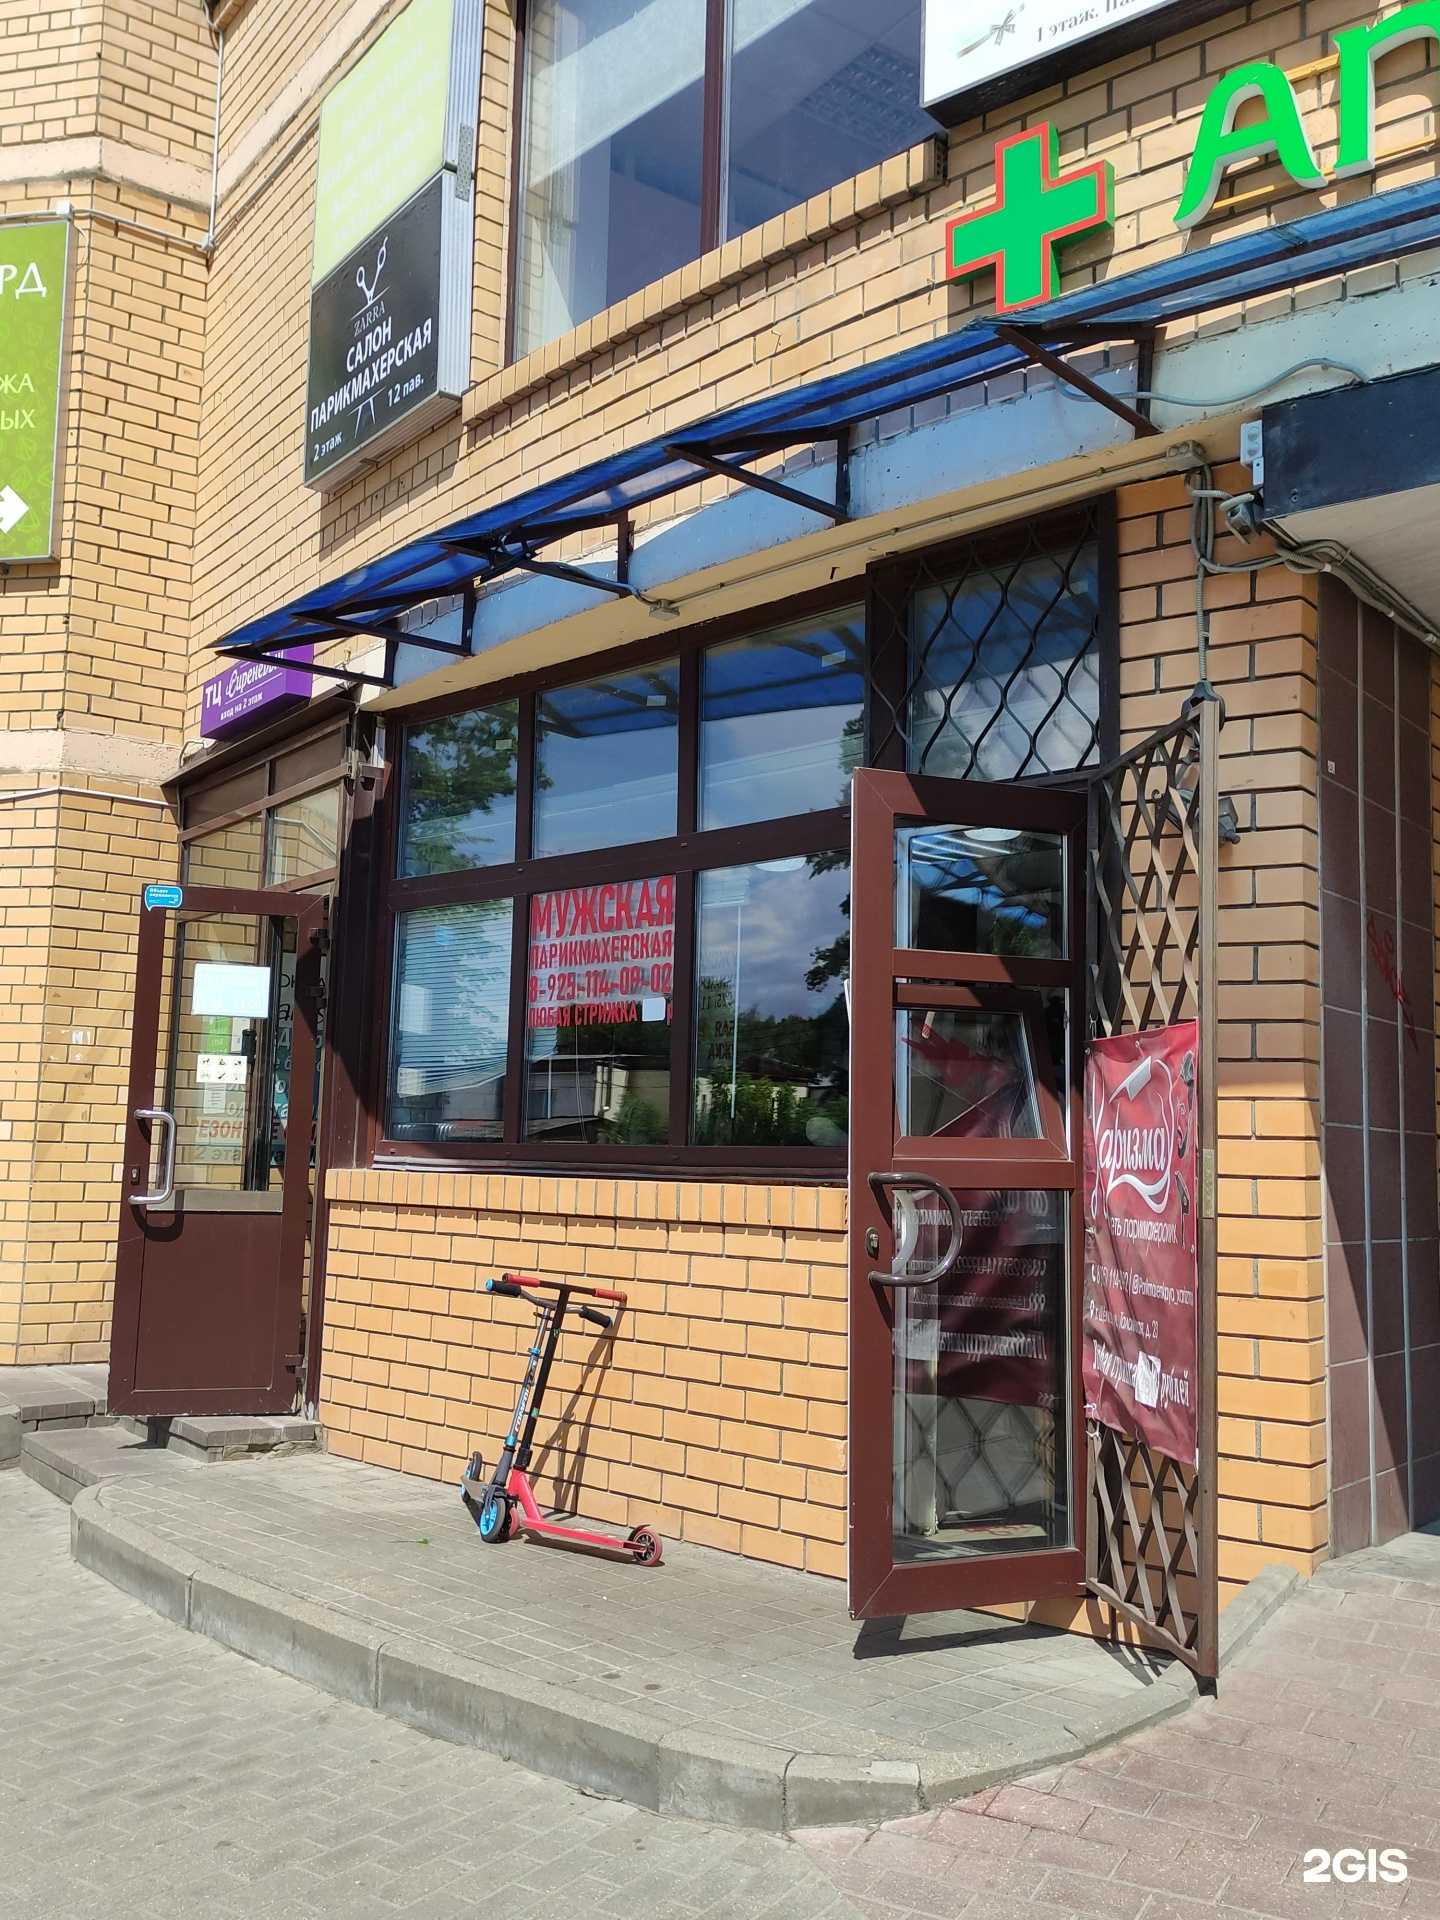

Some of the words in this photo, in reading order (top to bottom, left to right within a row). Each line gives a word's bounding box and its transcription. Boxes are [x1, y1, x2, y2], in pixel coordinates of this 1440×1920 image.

[353, 300, 386, 337] ZARRA
[346, 316, 392, 373] САЛОН
[310, 317, 432, 433] ПАРИКМАХЕРСКАЯ
[387, 384, 401, 408] 12
[402, 373, 424, 399] пав.
[313, 444, 320, 462] 2
[320, 433, 343, 457] этаж
[205, 680, 222, 709] ТЦ
[220, 707, 234, 721] вход
[234, 703, 242, 714] на
[242, 698, 248, 710] 2
[531, 875, 673, 940] МУЖСКАЯ
[529, 930, 673, 970] ПАРИКМАХЕРСКАЯ
[529, 962, 673, 1003] 8-925-114-09-02
[528, 1004, 571, 1028] ЛЮБАЯ
[574, 1000, 638, 1026] СТРИЖКА
